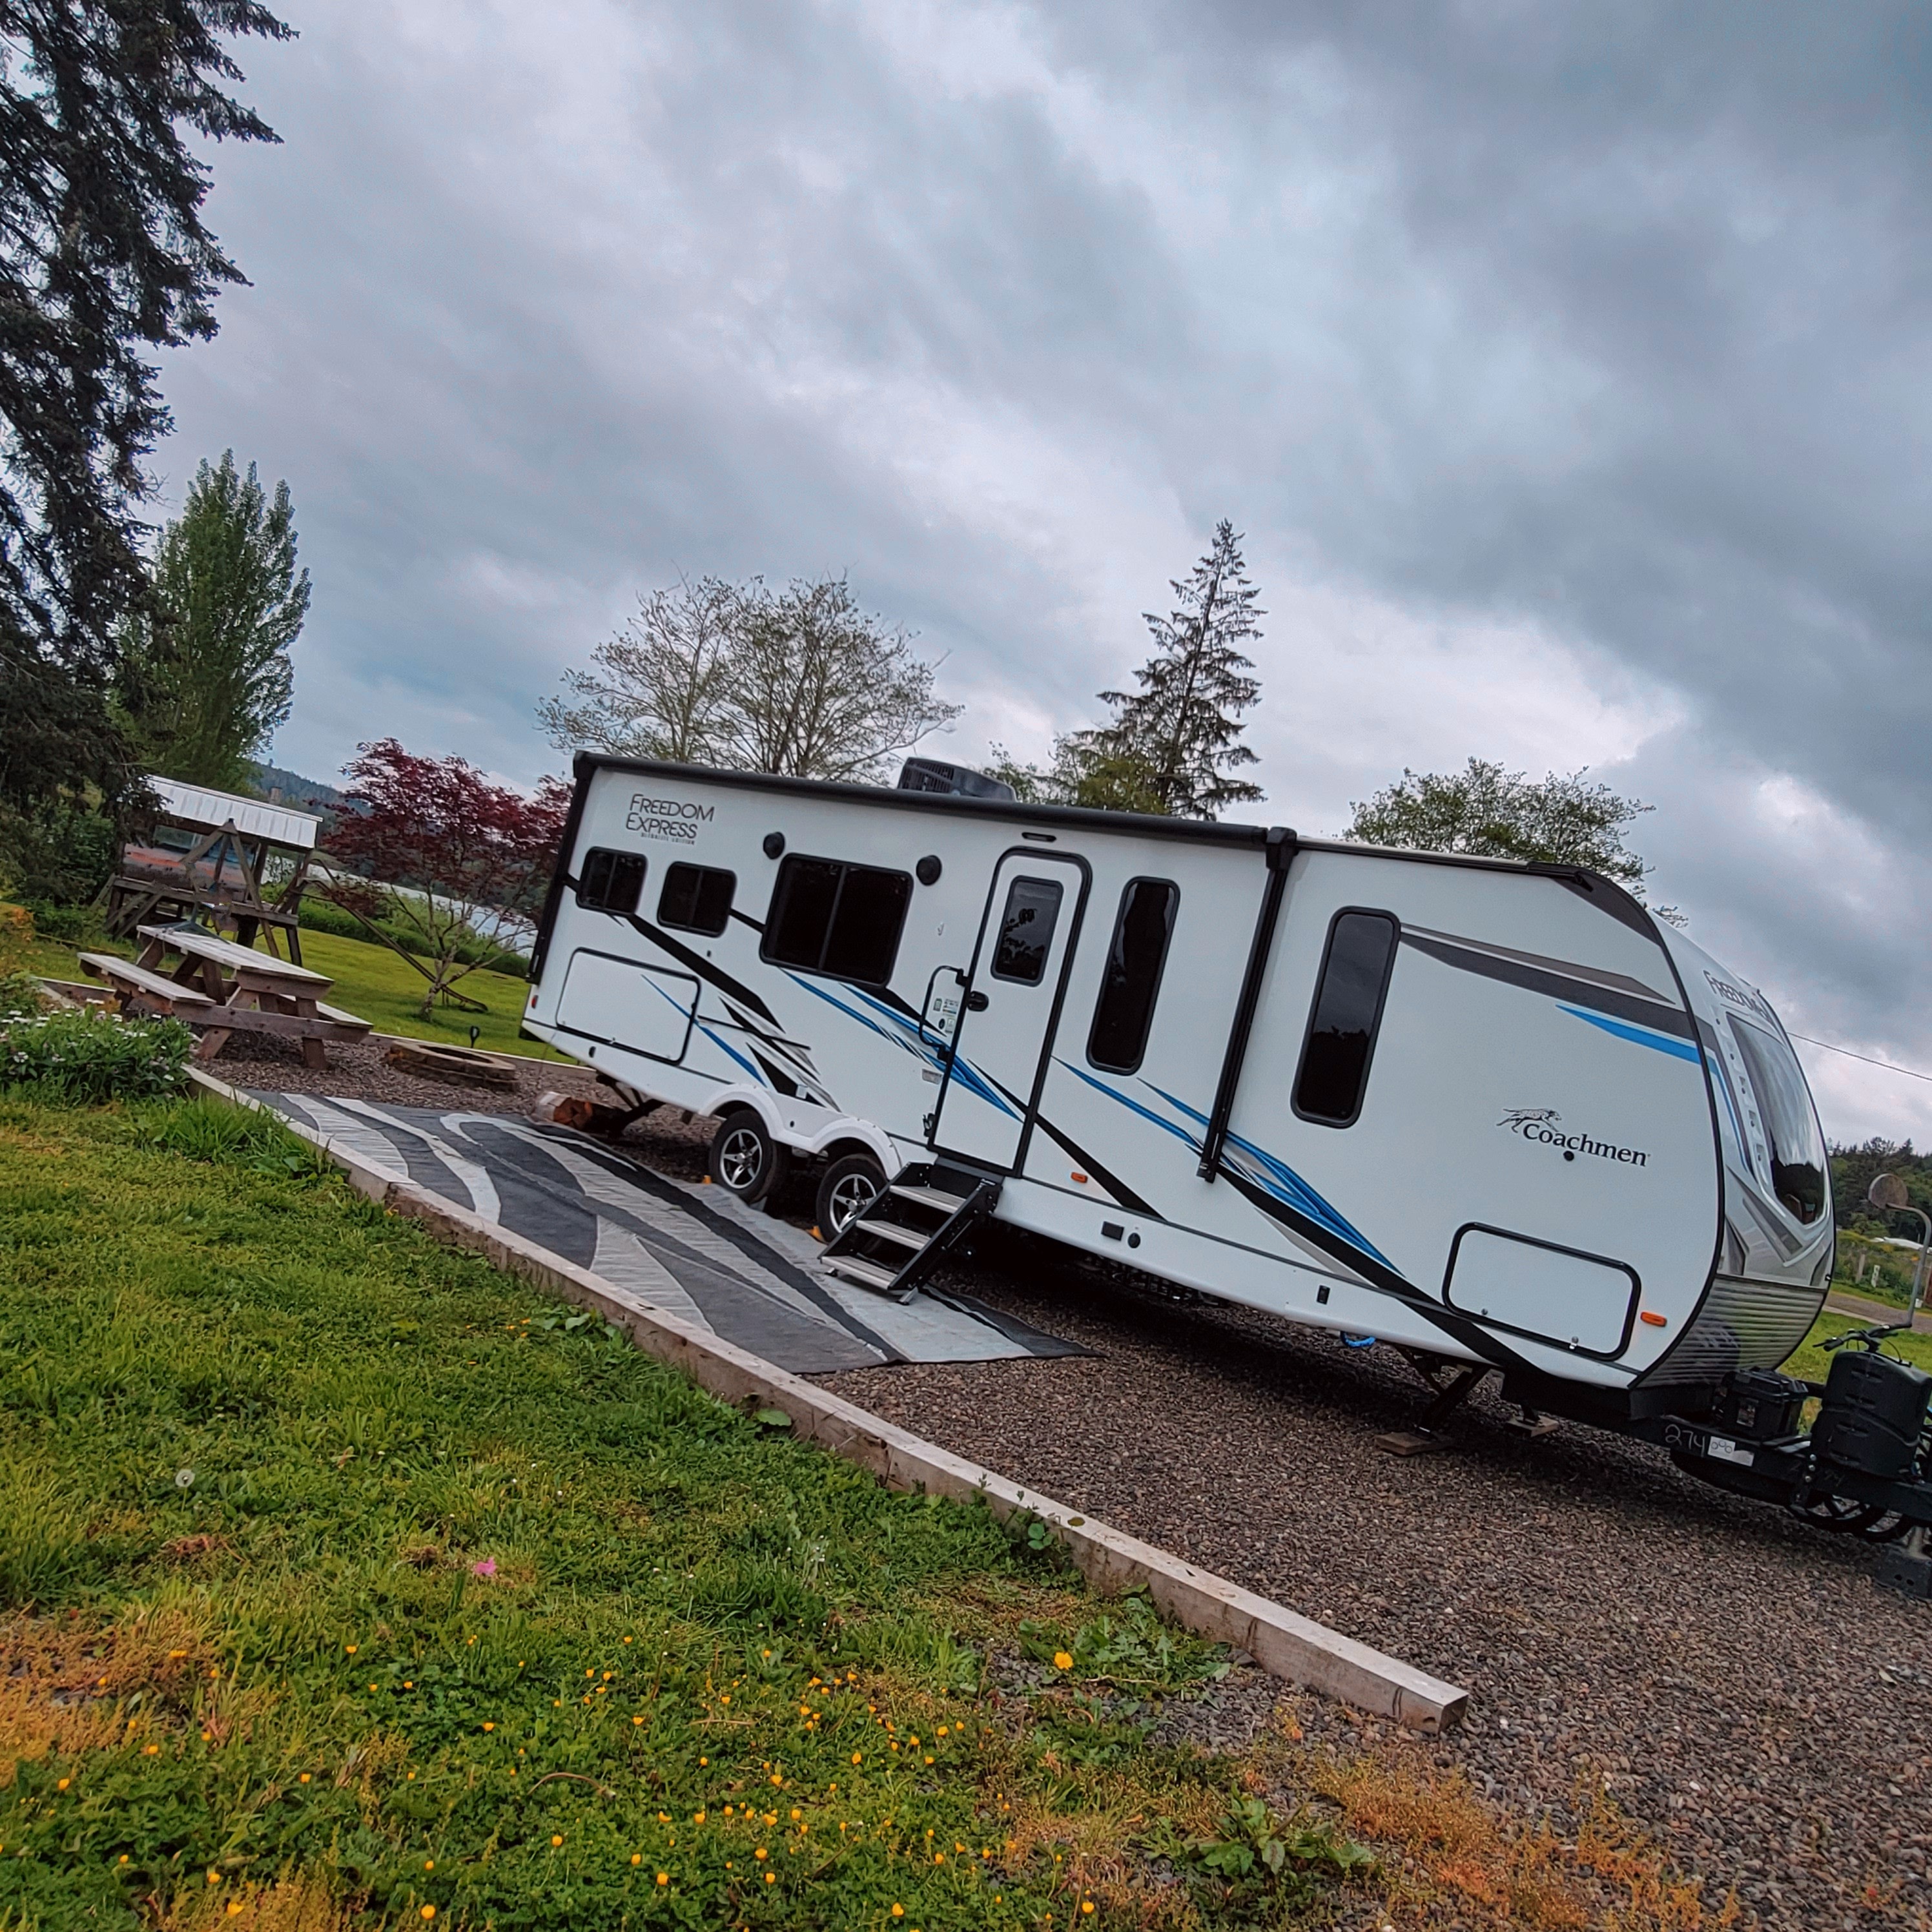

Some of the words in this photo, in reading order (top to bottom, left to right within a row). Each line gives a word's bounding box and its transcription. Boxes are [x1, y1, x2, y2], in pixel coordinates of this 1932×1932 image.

[630, 793, 715, 822] FREEDOM
[626, 812, 697, 839] EXPRESS
[1523, 1123, 1647, 1167] Coachmen
[1665, 1423, 1705, 1458] 274
